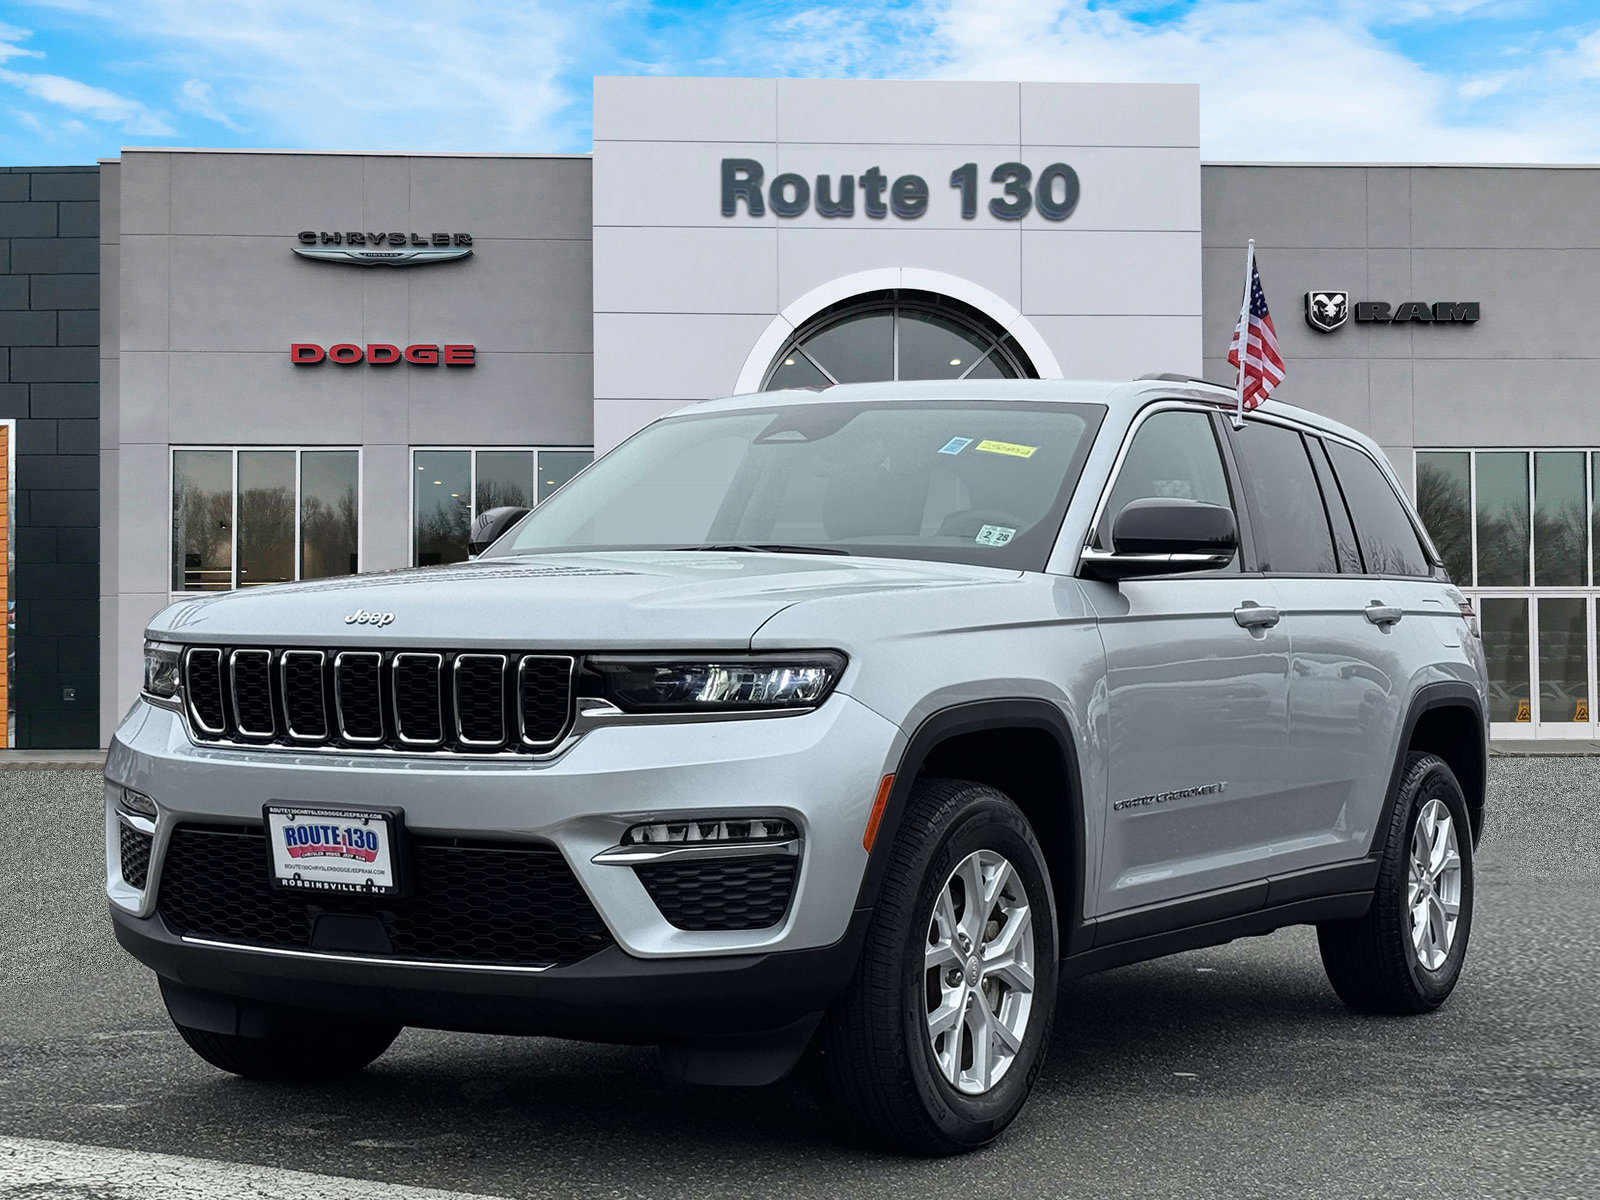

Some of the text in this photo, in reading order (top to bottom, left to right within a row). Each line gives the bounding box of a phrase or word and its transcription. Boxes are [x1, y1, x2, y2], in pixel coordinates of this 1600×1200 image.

[721, 158, 1081, 220] Route 130
[298, 231, 473, 245] CHRYSLER
[1354, 302, 1480, 324] RAM
[291, 343, 476, 366] DODGE
[983, 530, 1010, 542] 2 28
[344, 609, 396, 628] Jeep
[284, 825, 378, 851] ROUTE 130
[282, 879, 386, 894] ROBBINSVILLE, NJ
